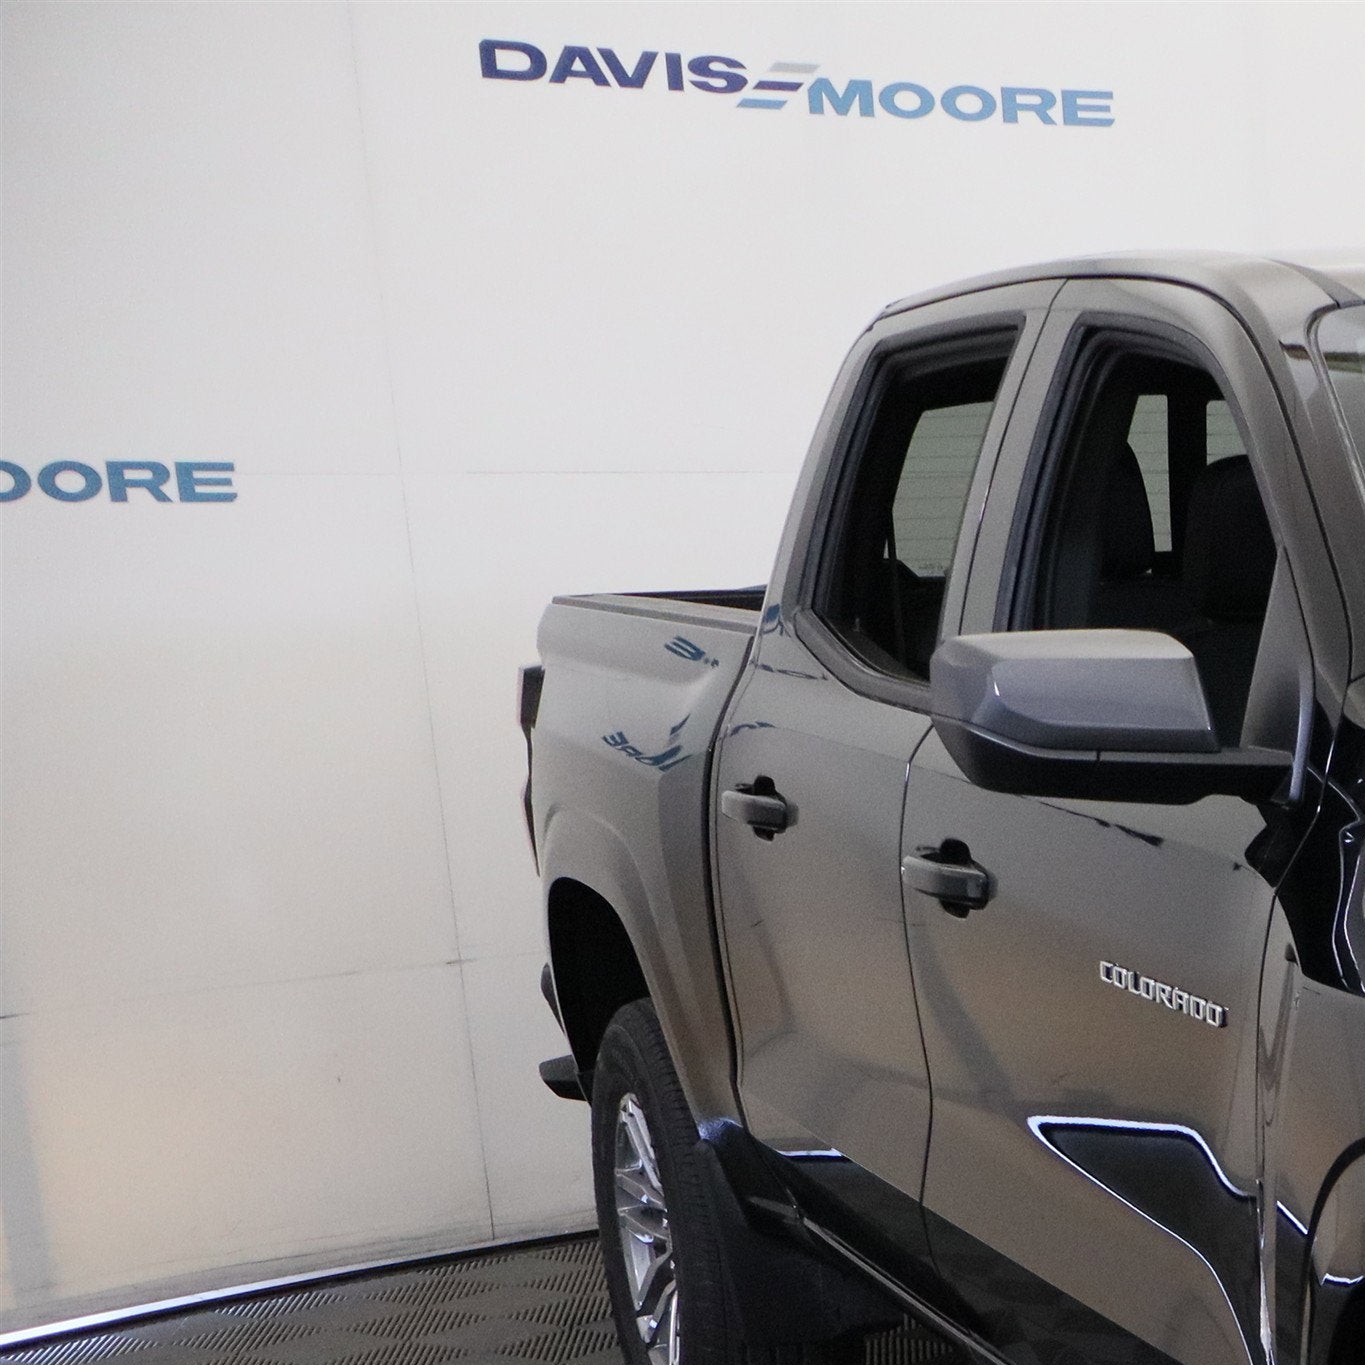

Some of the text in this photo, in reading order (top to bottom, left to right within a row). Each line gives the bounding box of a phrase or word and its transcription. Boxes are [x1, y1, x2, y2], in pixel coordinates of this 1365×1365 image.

[479, 39, 1115, 128] DAVIS MOORE
[1100, 960, 1224, 1027] COLORADO
